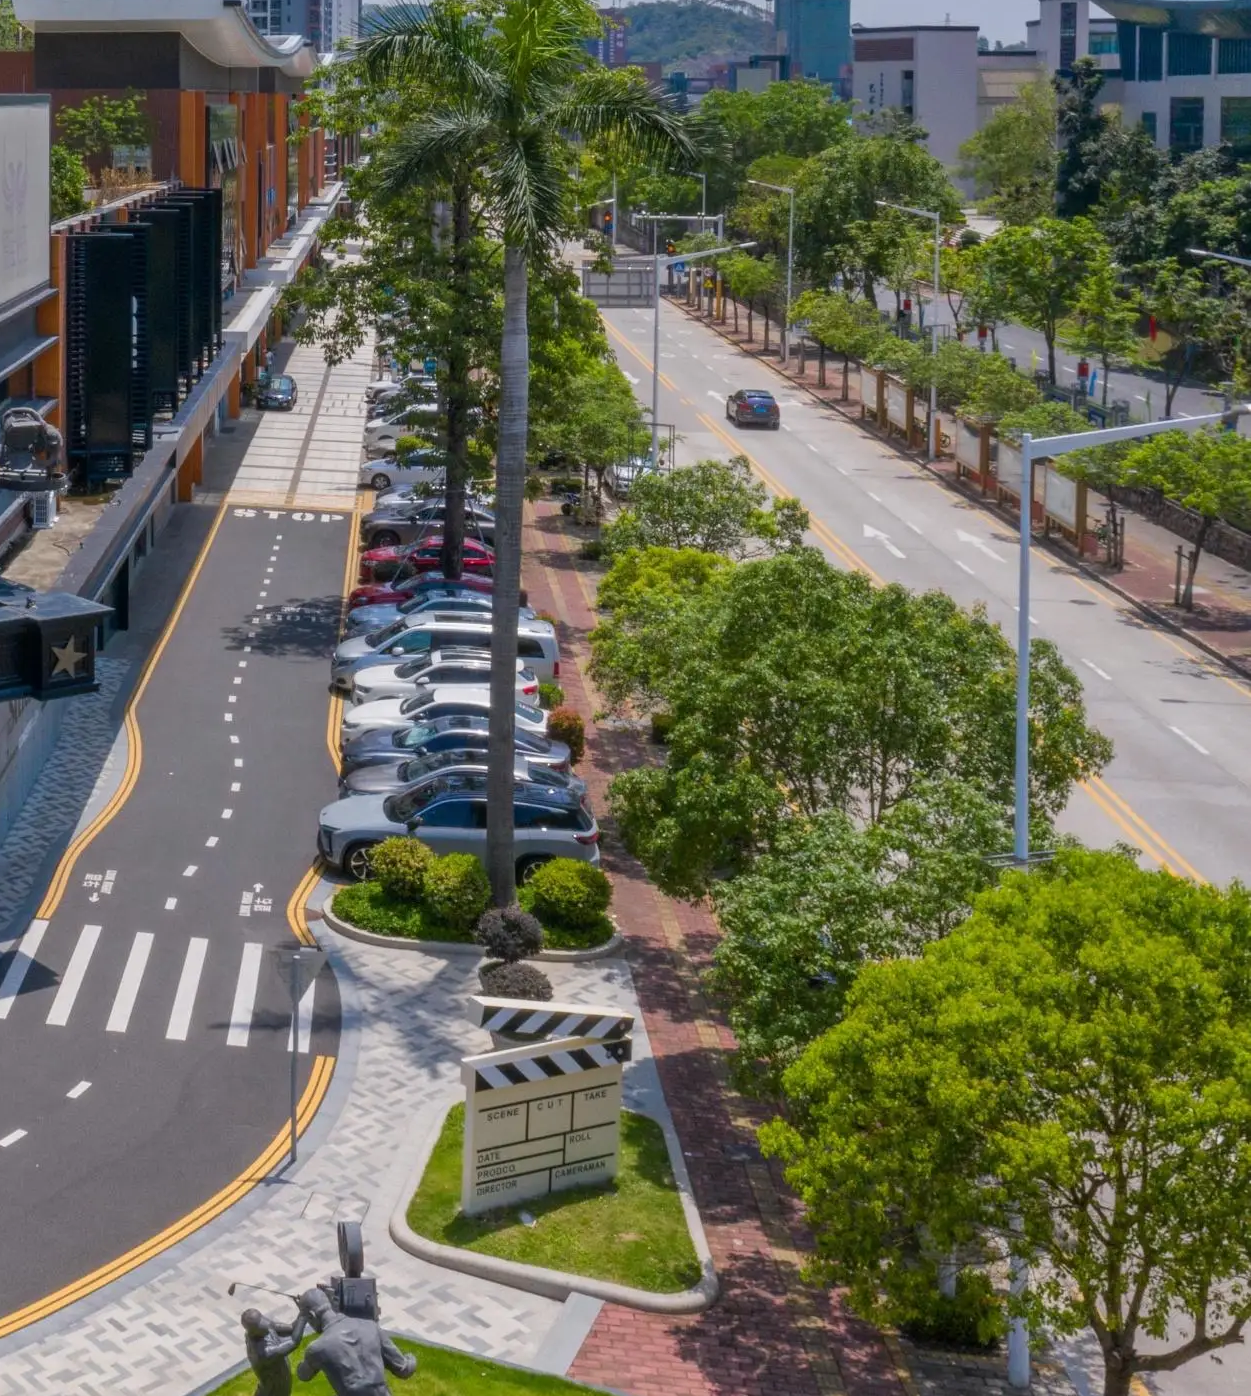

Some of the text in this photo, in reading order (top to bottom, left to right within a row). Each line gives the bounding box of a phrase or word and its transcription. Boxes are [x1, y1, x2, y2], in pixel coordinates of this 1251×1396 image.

[233, 508, 345, 523] STOP
[584, 1089, 608, 1101] TAKE
[486, 1107, 520, 1122] SCENE
[569, 1132, 592, 1144] ROLL
[477, 1152, 501, 1164] DATE
[554, 1160, 606, 1179] CAMERAMAN
[476, 1180, 518, 1196] DIRECTOR
